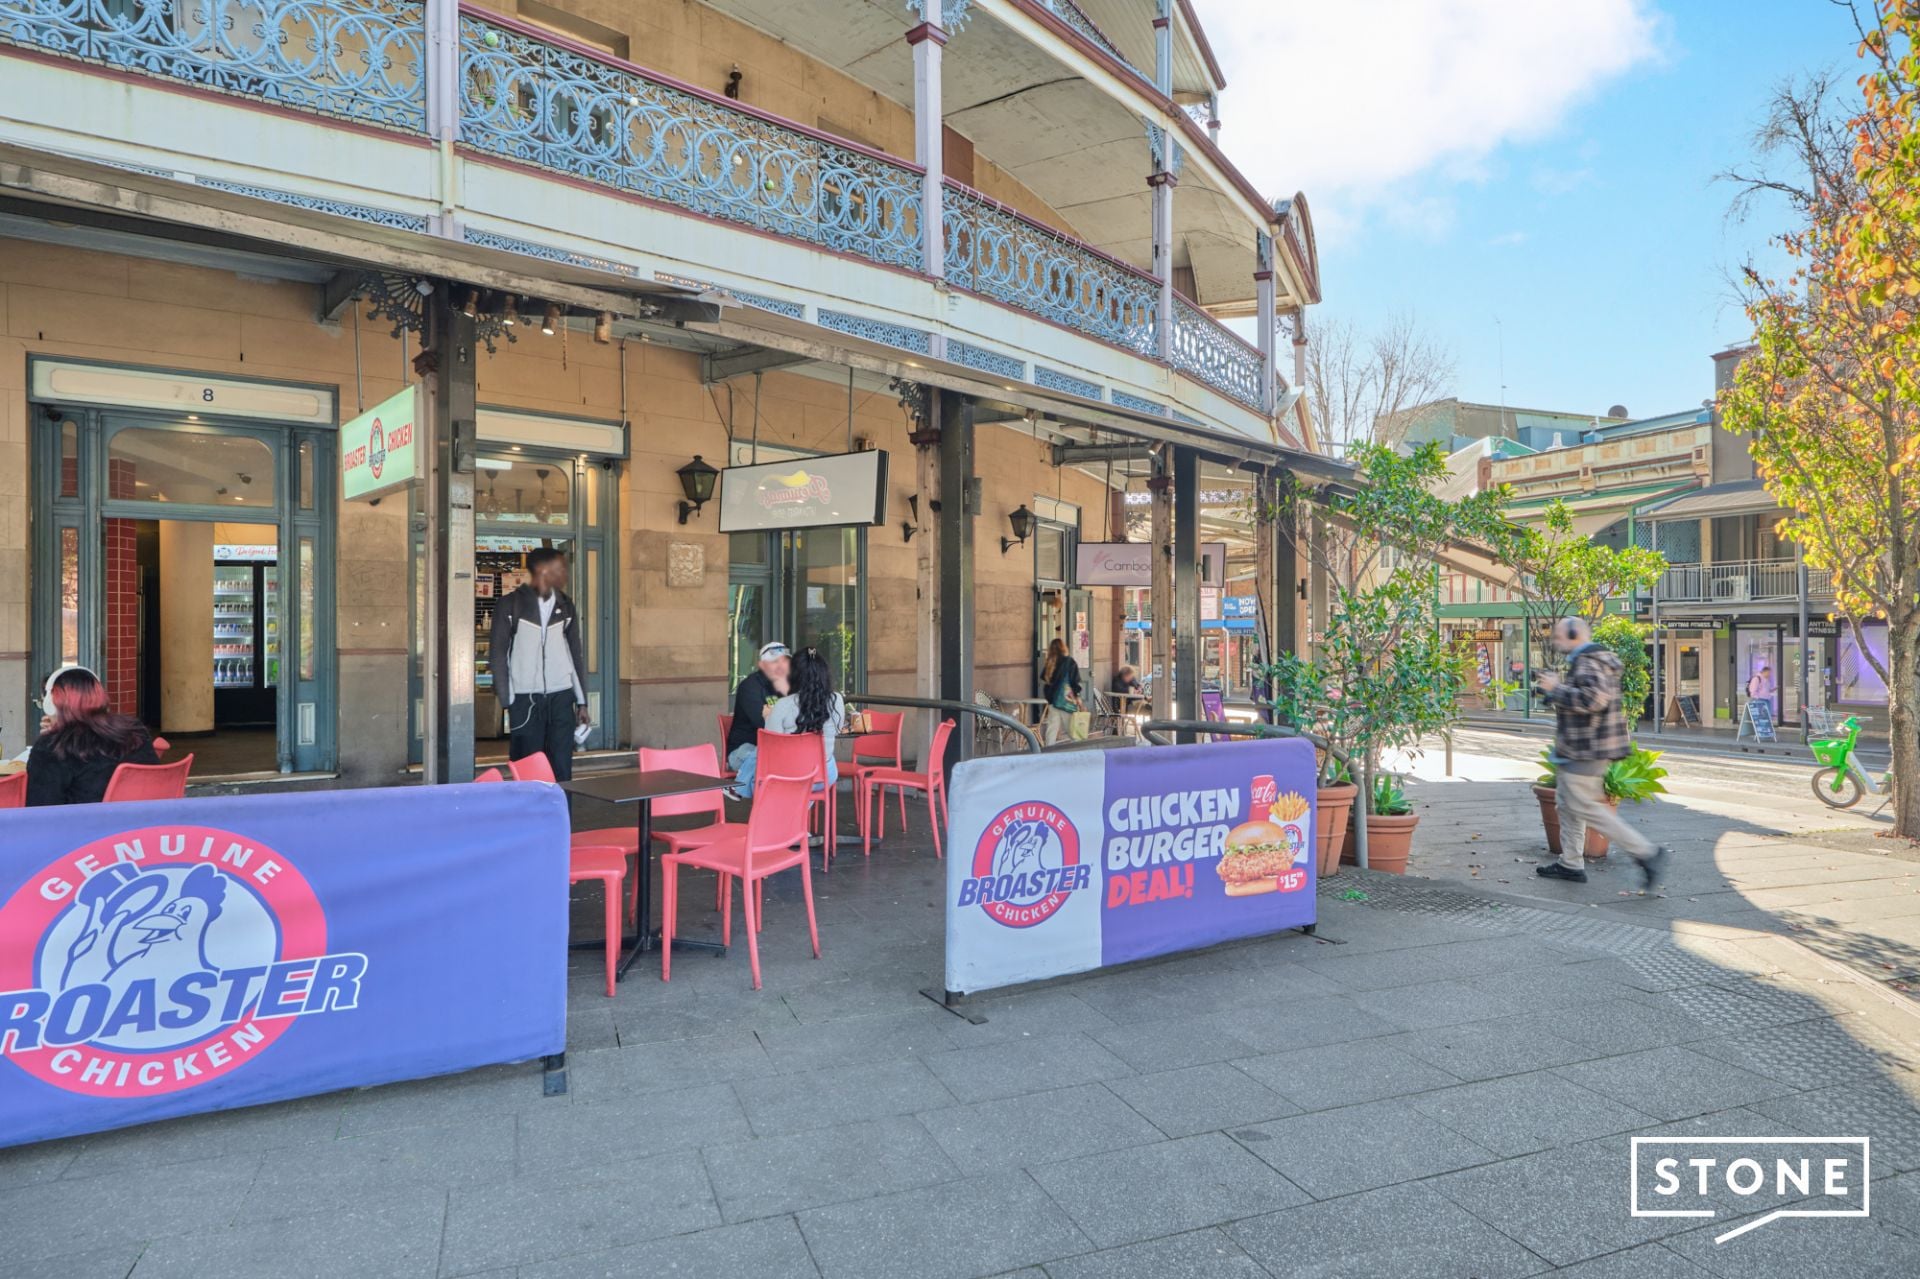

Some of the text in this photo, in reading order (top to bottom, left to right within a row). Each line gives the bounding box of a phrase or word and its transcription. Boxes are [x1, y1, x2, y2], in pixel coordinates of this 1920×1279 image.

[203, 388, 214, 402] 8
[387, 423, 412, 452] CHICKEN
[1104, 559, 1152, 571] Cambo
[992, 805, 1066, 837] GENUINE
[1108, 787, 1240, 832] CHICKEN
[39, 833, 283, 902] GENUINE
[1108, 823, 1231, 871] BURGER
[957, 863, 1091, 907] BROASTER
[1107, 862, 1195, 909] DEAL!
[995, 894, 1059, 922] CHICKEN
[0, 952, 369, 1054] ROASTER
[50, 1021, 265, 1087] CHICKEN
